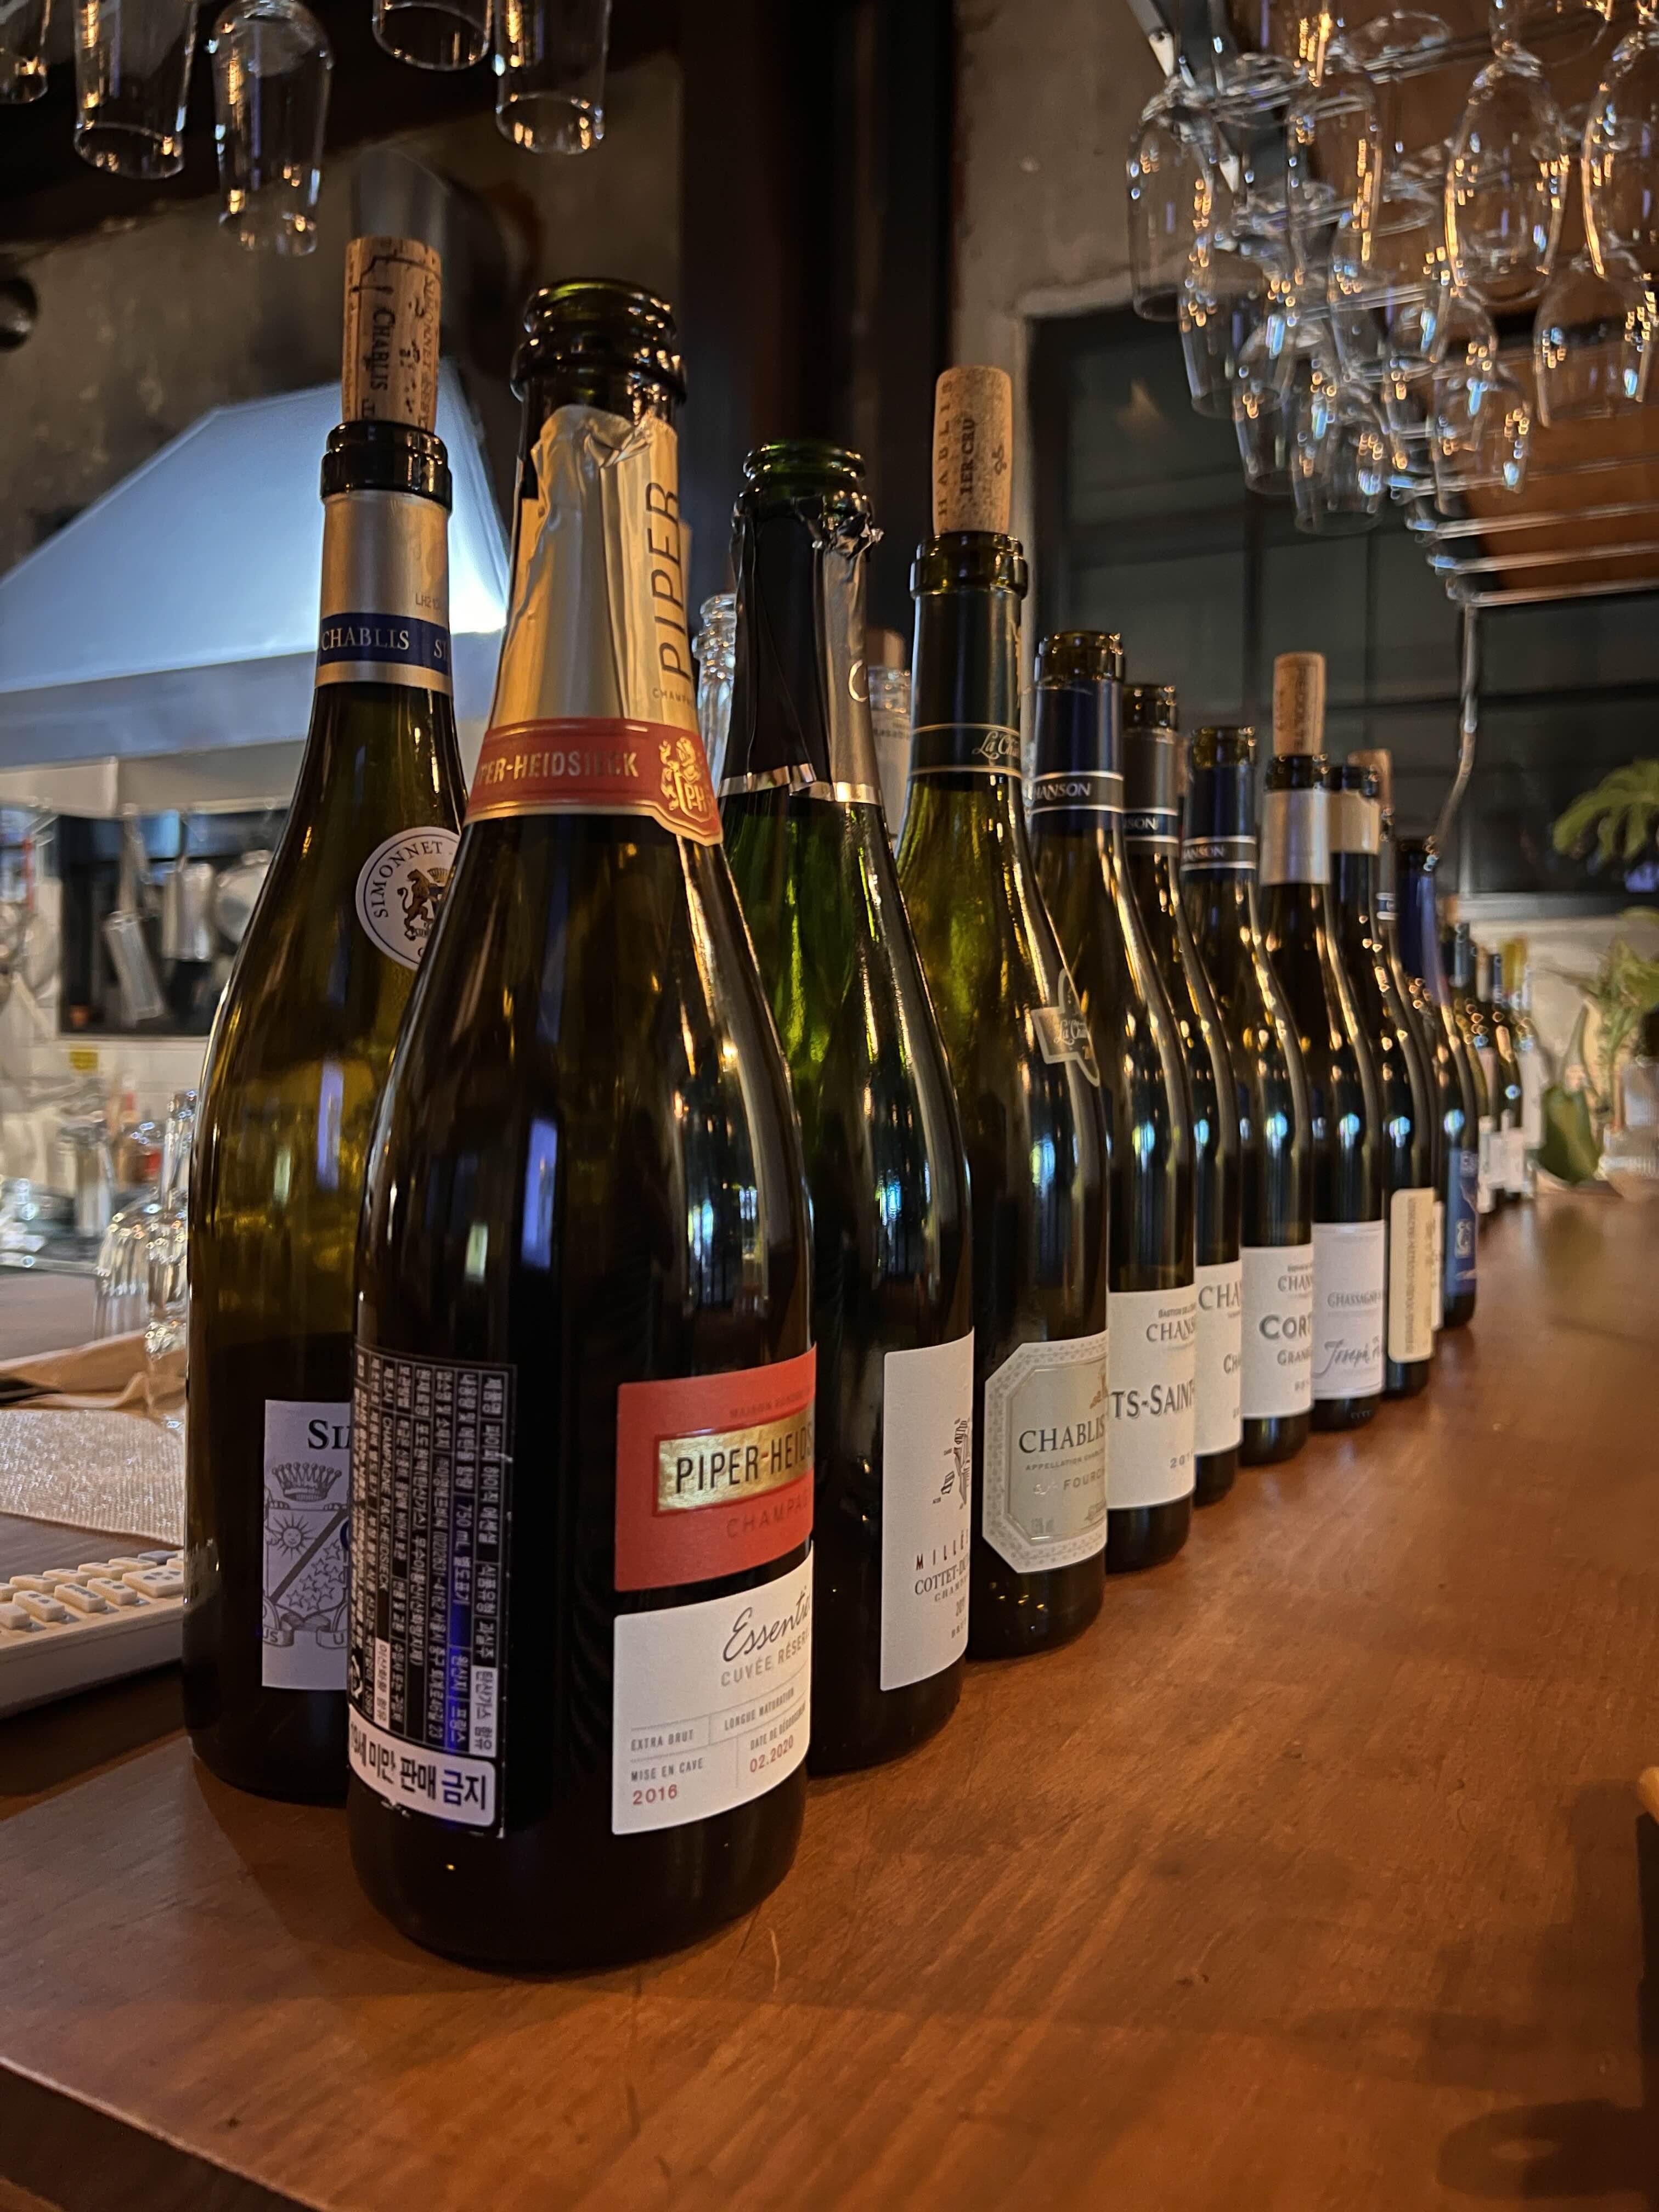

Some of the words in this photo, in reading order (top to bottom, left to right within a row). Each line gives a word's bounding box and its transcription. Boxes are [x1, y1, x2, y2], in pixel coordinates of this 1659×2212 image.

[371, 307, 396, 391] CHABLIS
[938, 381, 952, 531] HABLIS
[961, 419, 975, 455] CRU
[645, 482, 692, 681] PIPER
[321, 627, 410, 651] CHABLIS
[371, 841, 443, 918] SIMONNET
[1019, 1414, 1105, 1453] CHABLIS
[381, 1417, 393, 1494] CHAMPAGNE
[455, 1504, 472, 1527] 750
[379, 1526, 390, 1592] HEIDSIECK
[720, 1655, 772, 1686] CUVÉE
[475, 1671, 493, 1720] 탄산가스
[450, 1706, 467, 1742] 프랑스
[630, 1734, 663, 1751] EXTRA
[668, 1729, 694, 1745] BRUT
[750, 1733, 768, 1751] DATE
[631, 1765, 657, 1782] MISE
[661, 1764, 675, 1777] EN
[679, 1757, 704, 1774] CAVE
[749, 1734, 794, 1773] 02.2020
[369, 1740, 396, 1785] 미만
[400, 1757, 437, 1800] 판매
[441, 1769, 486, 1811] 금지
[633, 1784, 678, 1805] 2016
